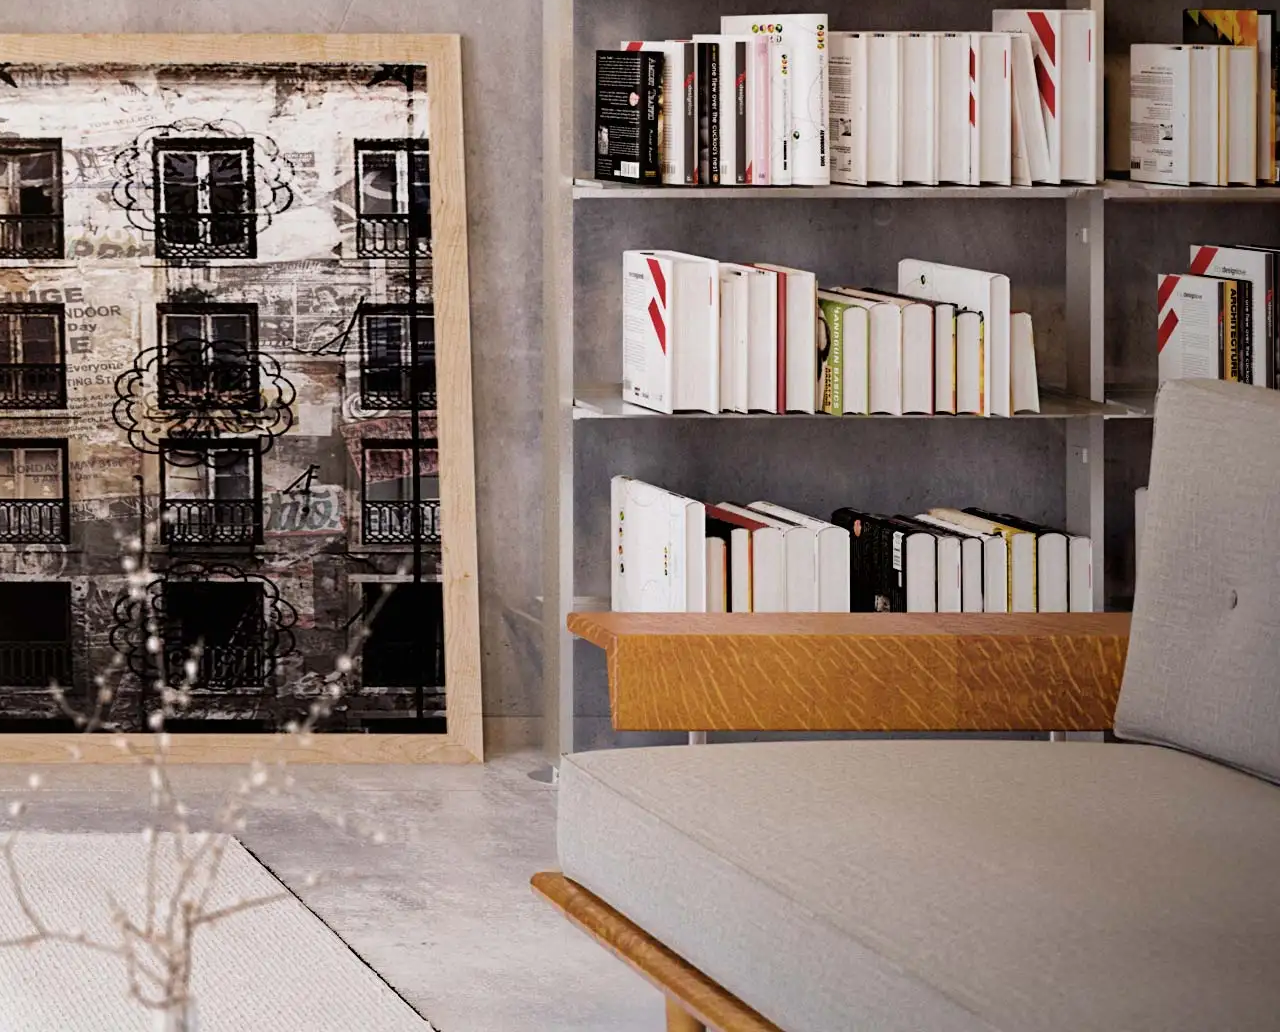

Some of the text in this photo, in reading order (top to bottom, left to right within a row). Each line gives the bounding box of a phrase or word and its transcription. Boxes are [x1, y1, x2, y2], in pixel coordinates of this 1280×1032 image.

[648, 57, 656, 121] AMIDST TRAFFIC
[65, 305, 122, 319] NDOOR
[68, 323, 97, 332] Day
[1230, 288, 1238, 377] ARCHITECTURE
[66, 363, 124, 373] Everyone
[6, 463, 58, 474] MONDAY
